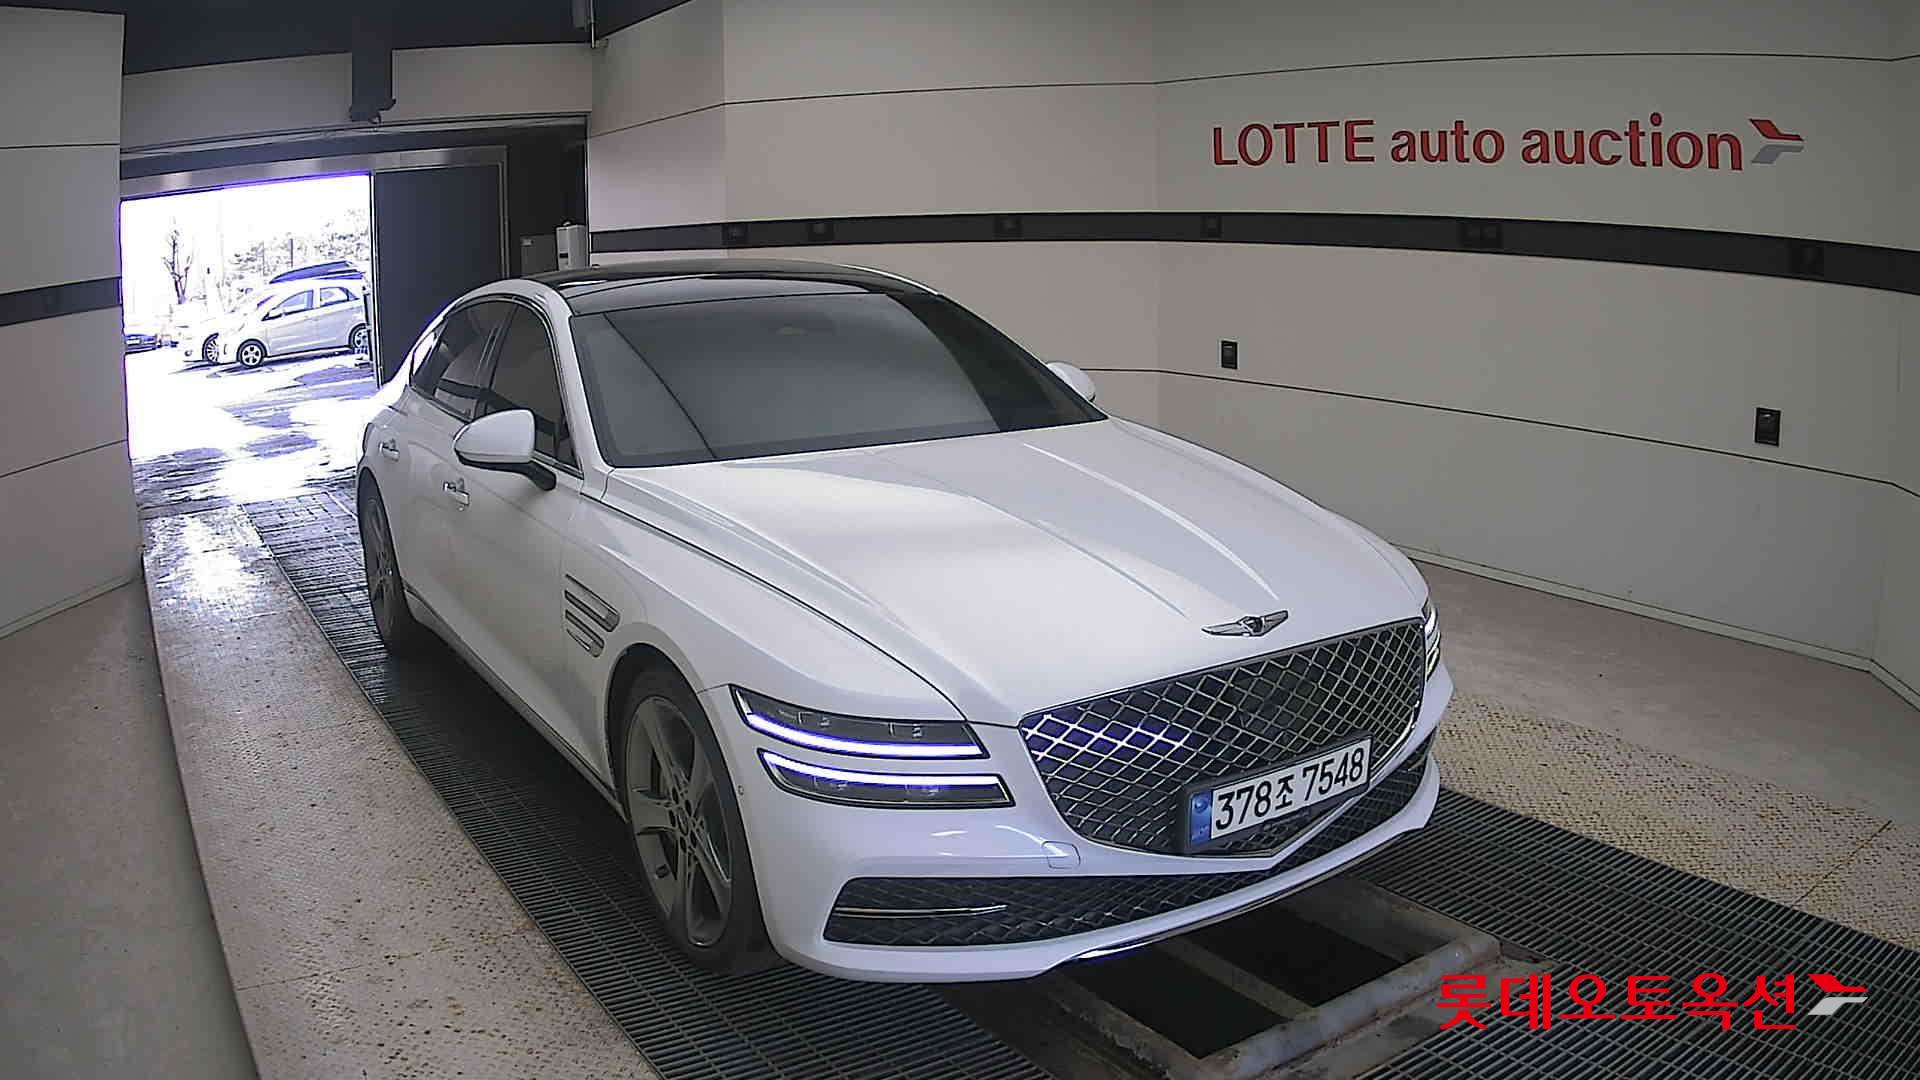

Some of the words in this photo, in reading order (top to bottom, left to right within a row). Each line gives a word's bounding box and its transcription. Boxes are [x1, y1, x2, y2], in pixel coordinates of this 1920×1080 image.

[1212, 119, 1376, 167] LOTTE
[1391, 119, 1505, 164] auto
[1521, 111, 1743, 172] auction
[1215, 773, 1295, 831] 378조
[1302, 747, 1365, 801] 7548
